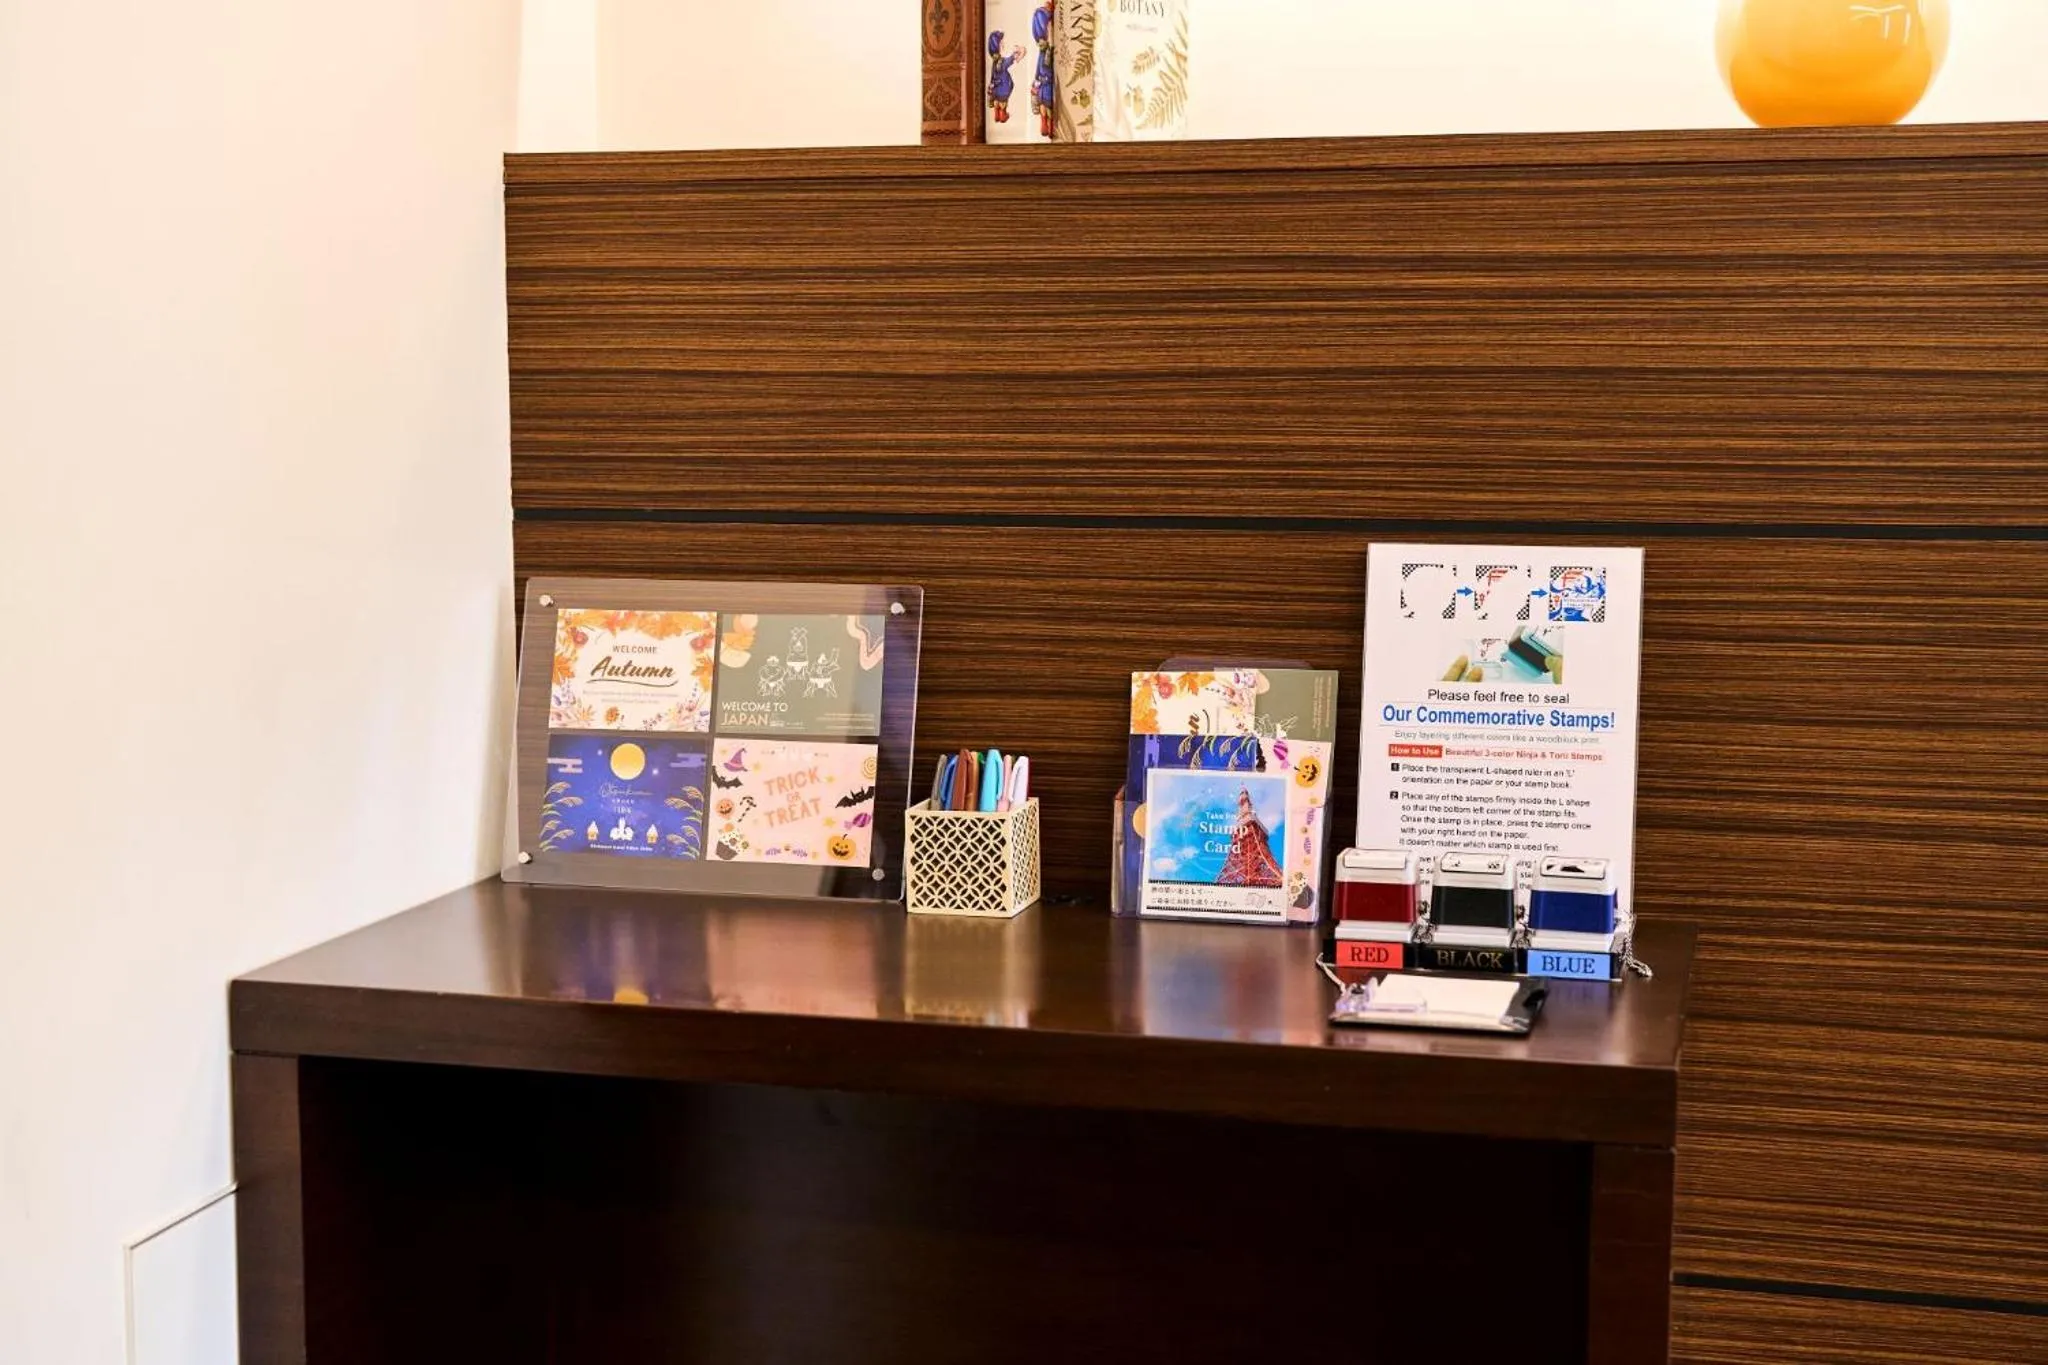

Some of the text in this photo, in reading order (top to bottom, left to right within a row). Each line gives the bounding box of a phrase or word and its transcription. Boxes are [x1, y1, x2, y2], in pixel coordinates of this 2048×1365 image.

[612, 645, 658, 654] WELCOME
[590, 656, 674, 678] Autumn
[1428, 689, 1570, 704] Please feel free to seal
[721, 701, 788, 712] WELCOME TO
[720, 713, 769, 726] JAPAN
[1383, 704, 1615, 732] Our Commemorative Stamps!
[1394, 730, 1417, 740] Enjoy
[1419, 731, 1451, 741] layering
[1452, 732, 1485, 740] different
[1512, 734, 1526, 742] like
[1536, 735, 1579, 744] woodblock
[1391, 745, 1411, 754] How
[1411, 746, 1421, 755] to
[1423, 746, 1440, 756] Use
[1445, 747, 1483, 756] Beautiful
[1485, 749, 1514, 757] 3-color
[1516, 750, 1538, 759] Ninja
[1540, 751, 1547, 759] &
[1571, 752, 1603, 761] Stamps
[1401, 764, 1424, 772] Place
[1426, 764, 1438, 773] the
[1440, 764, 1484, 774] transparent
[1486, 767, 1523, 775] L-shaped
[1524, 768, 1542, 776] ruler
[763, 766, 821, 797] TRICK
[1401, 776, 1442, 784] orientation
[1456, 777, 1468, 785] the
[1470, 778, 1493, 786] paper
[1505, 780, 1522, 788] your
[1524, 780, 1549, 788] stamp
[786, 792, 800, 803] OR
[1401, 791, 1424, 800] Place
[1441, 793, 1450, 801] of
[1450, 793, 1463, 801] the
[1465, 795, 1494, 803] stamps
[1495, 795, 1516, 805] firmly
[1519, 797, 1542, 805] inside
[1543, 797, 1556, 805] the
[1558, 798, 1564, 806] L
[1565, 799, 1590, 807] shape
[763, 797, 822, 829] TREAT
[1412, 804, 1427, 812] that
[1429, 804, 1442, 812] the
[1443, 805, 1471, 813] bottom
[1472, 806, 1485, 814] left
[1523, 808, 1536, 816] the
[1537, 809, 1561, 817] stamp
[1400, 814, 1422, 823] Once
[1423, 815, 1436, 824] the
[1438, 817, 1461, 825] stamp
[1530, 820, 1543, 828] the
[1545, 821, 1569, 829] stamp
[1199, 821, 1249, 839] Stamp
[1418, 828, 1435, 836] your
[1437, 828, 1455, 837] right
[1456, 829, 1476, 837] hand
[1204, 840, 1241, 854] Card
[1463, 840, 1486, 848] which
[1488, 841, 1512, 850] stamp
[1522, 843, 1542, 851] used
[1351, 946, 1389, 963] RED
[1436, 950, 1505, 969] BLACK
[1541, 956, 1596, 975] BLUE
